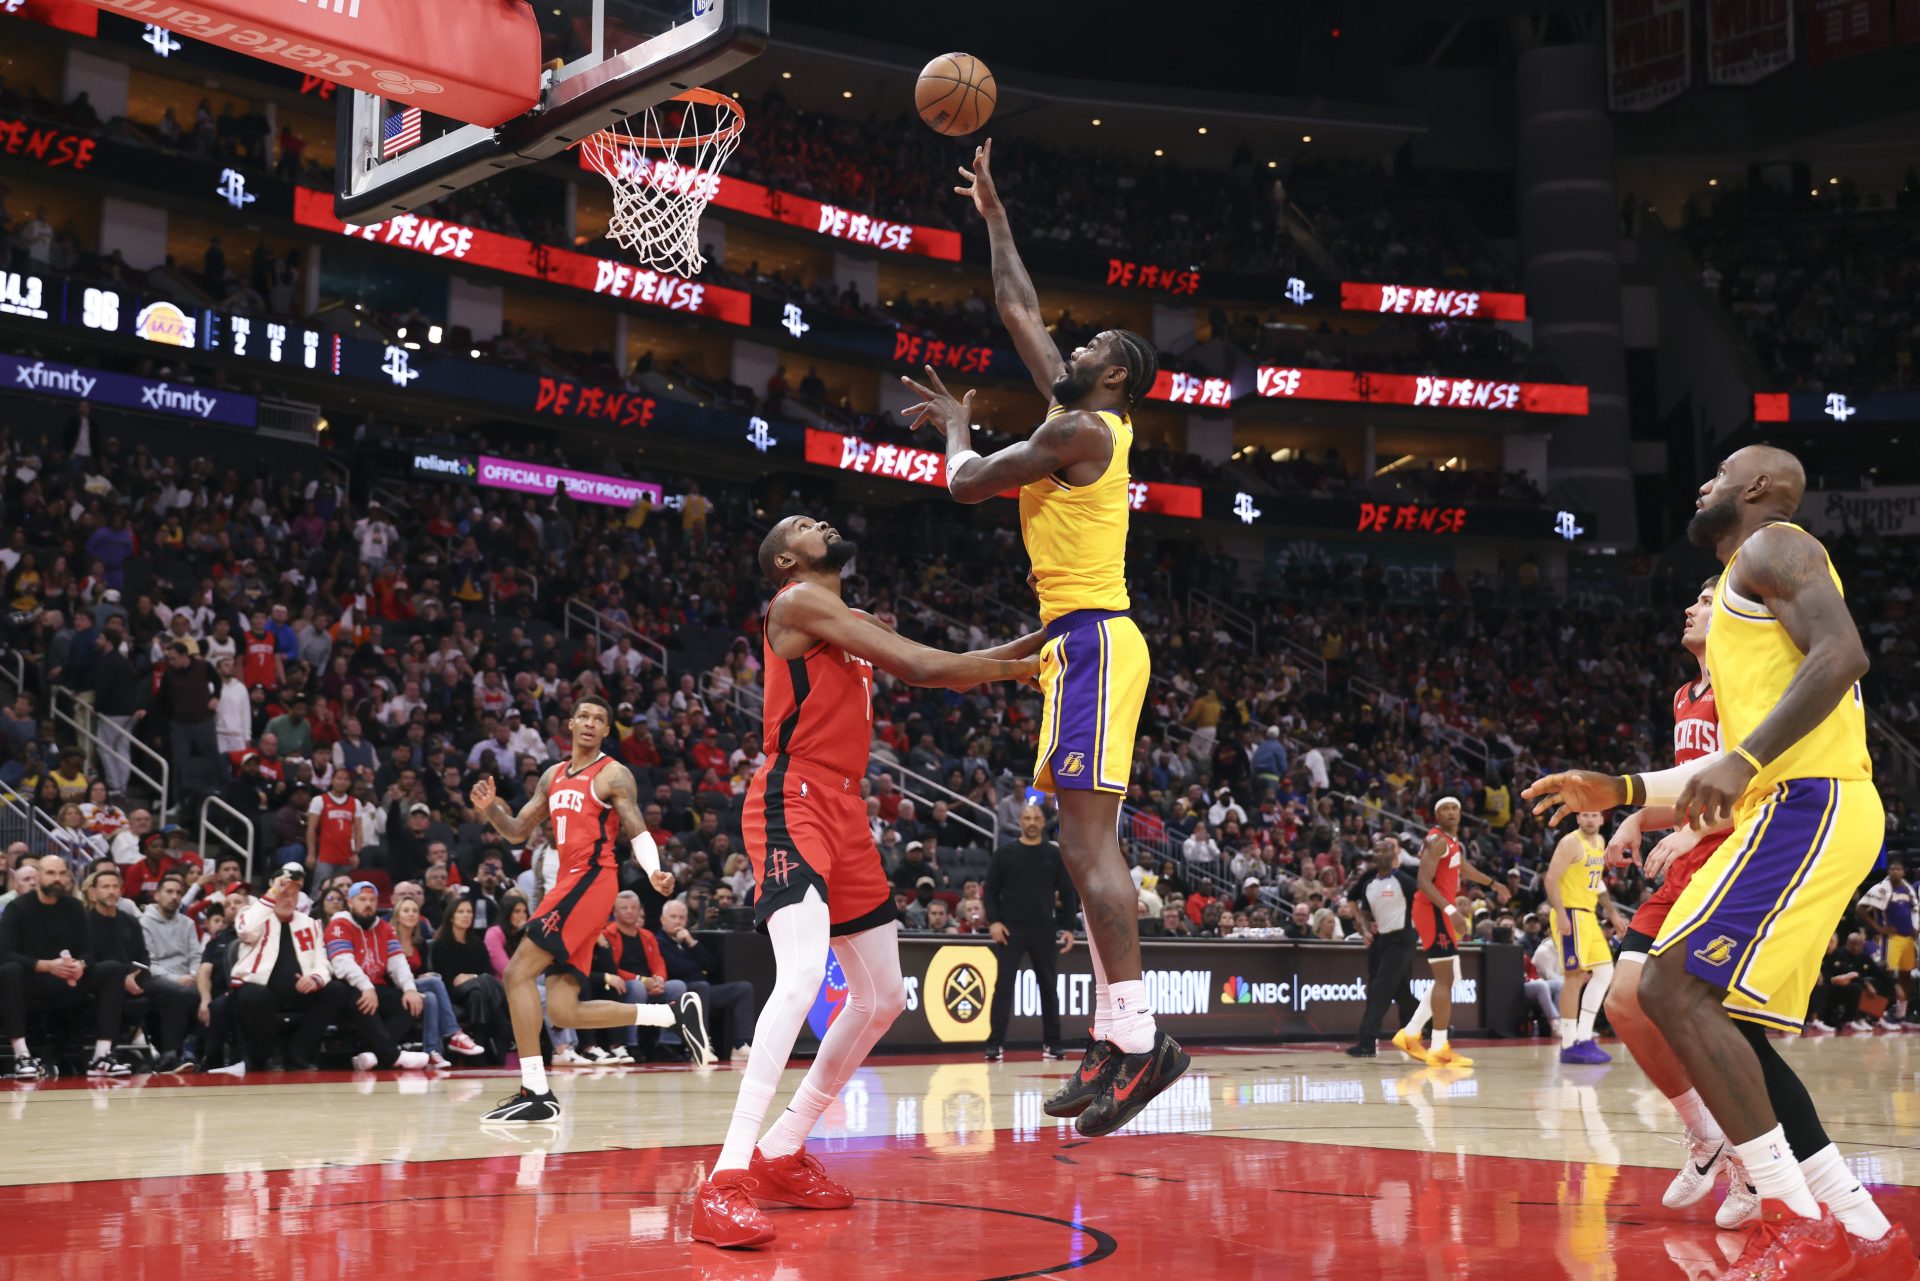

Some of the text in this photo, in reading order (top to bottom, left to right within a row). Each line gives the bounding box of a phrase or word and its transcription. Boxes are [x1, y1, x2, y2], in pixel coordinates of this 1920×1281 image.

[16, 362, 97, 397] xfinity
[140, 383, 216, 417] xfinity
[414, 455, 460, 475] reliant
[483, 464, 544, 489] OFFICIAL
[1069, 973, 1092, 1016] ET
[1252, 982, 1290, 1004] NBC
[1300, 977, 1367, 1011] peacock
